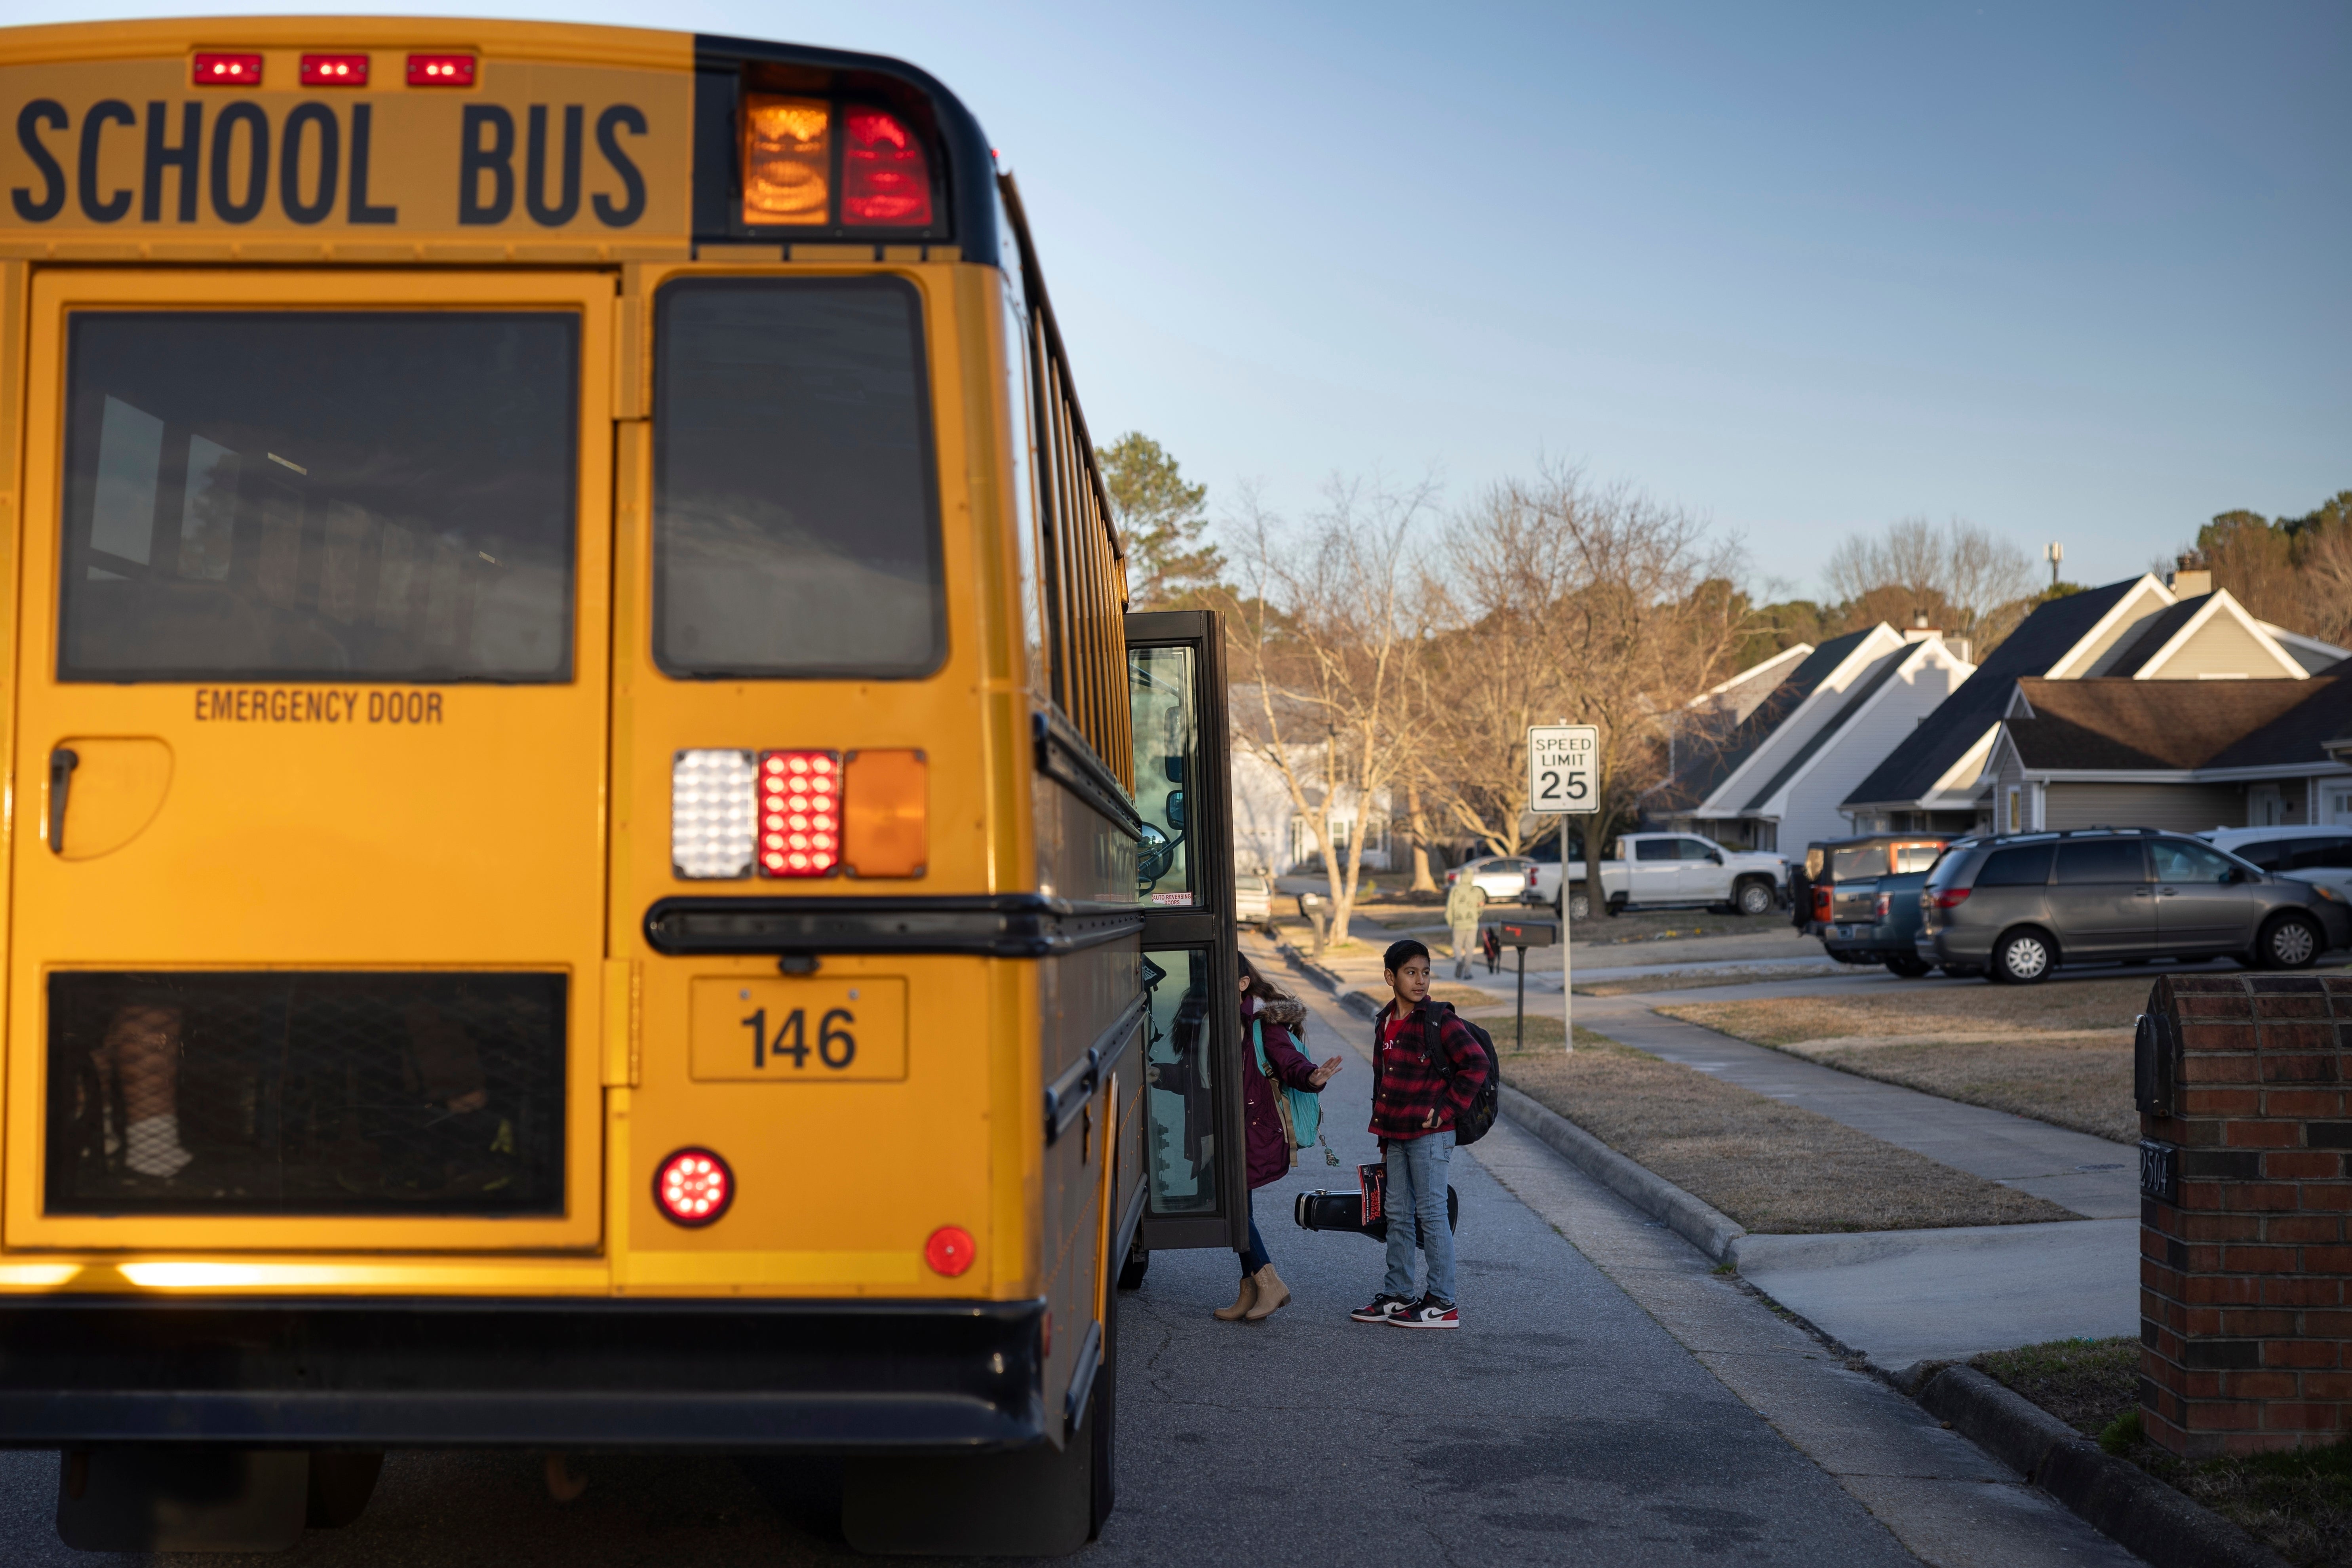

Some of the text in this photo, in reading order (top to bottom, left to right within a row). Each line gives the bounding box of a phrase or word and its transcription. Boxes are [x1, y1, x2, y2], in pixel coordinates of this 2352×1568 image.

[10, 97, 649, 228] SCHOOL BUS
[196, 689, 443, 724] EMERGENCY DOOR
[1536, 738, 1591, 750] SPEED
[1542, 754, 1585, 766] LIMIT
[1541, 771, 1587, 799] 25
[741, 1007, 856, 1069] 146
[2141, 1149, 2167, 1194] 2504
